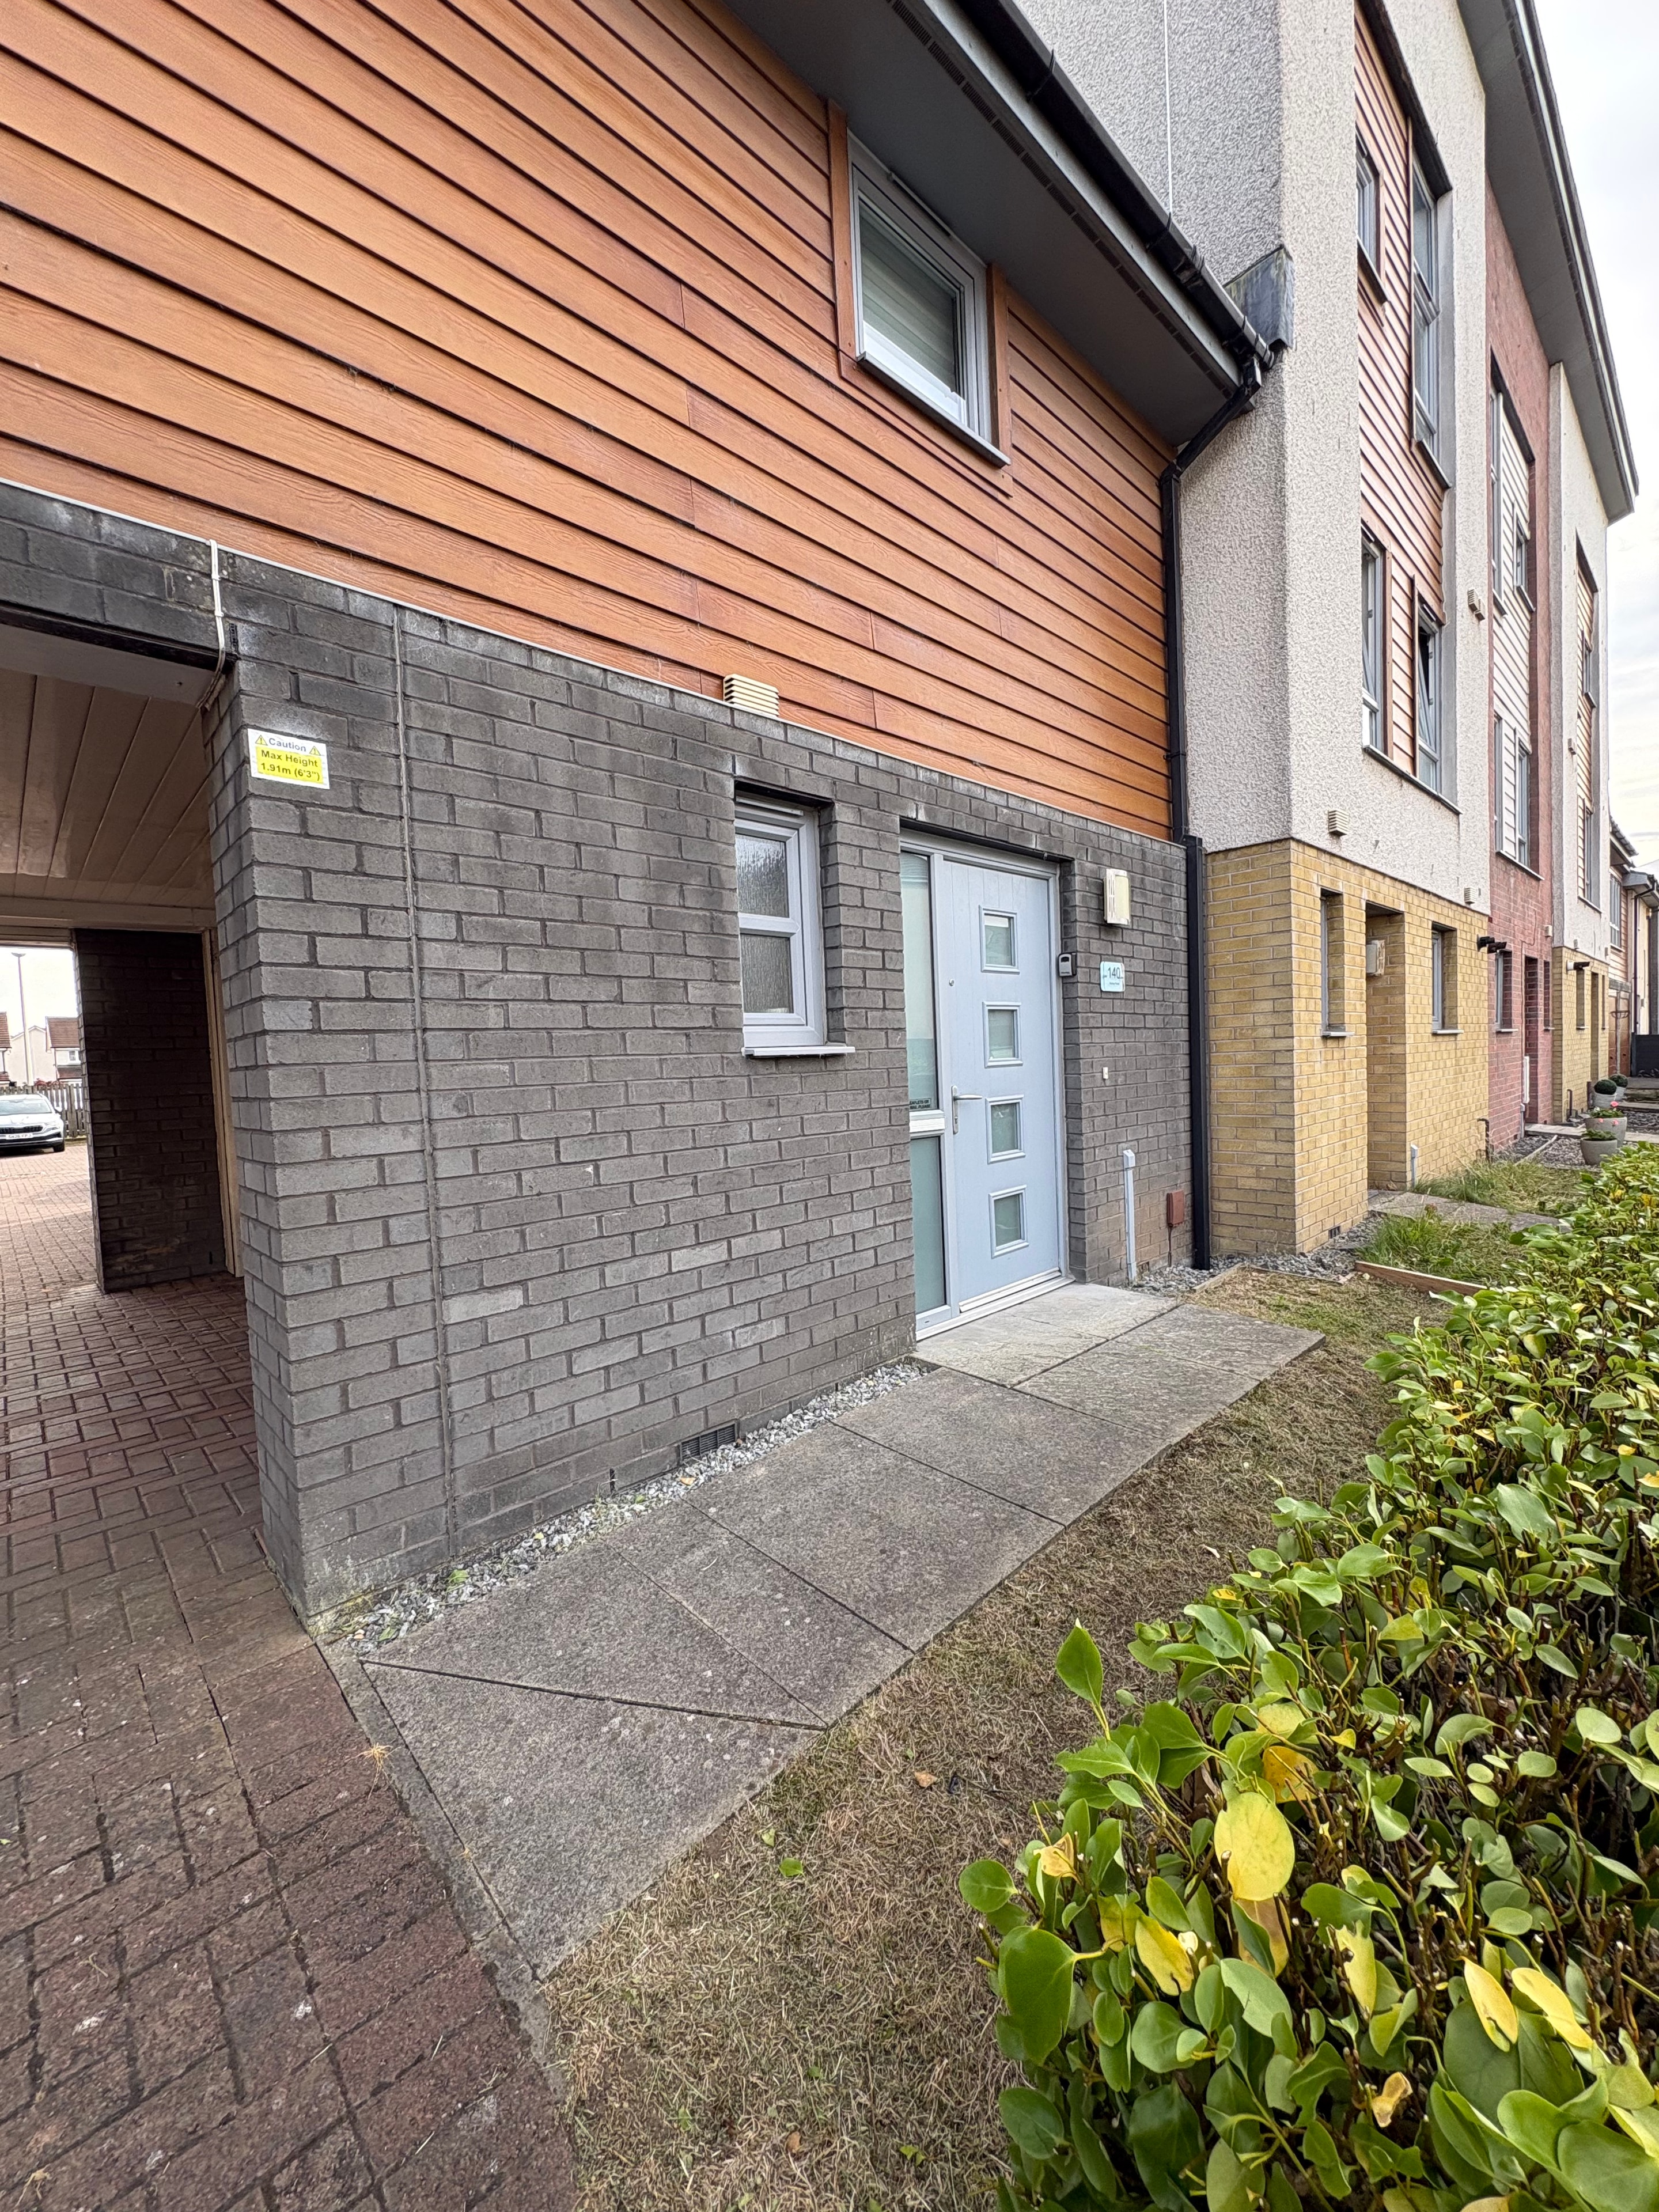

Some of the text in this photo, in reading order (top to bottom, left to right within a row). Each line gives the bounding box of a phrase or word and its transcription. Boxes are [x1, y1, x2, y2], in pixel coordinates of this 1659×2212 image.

[268, 738, 306, 752] Caution
[261, 749, 318, 767] Max Height
[260, 763, 320, 781] 1.91m (6'3")
[1108, 967, 1120, 979] 140
